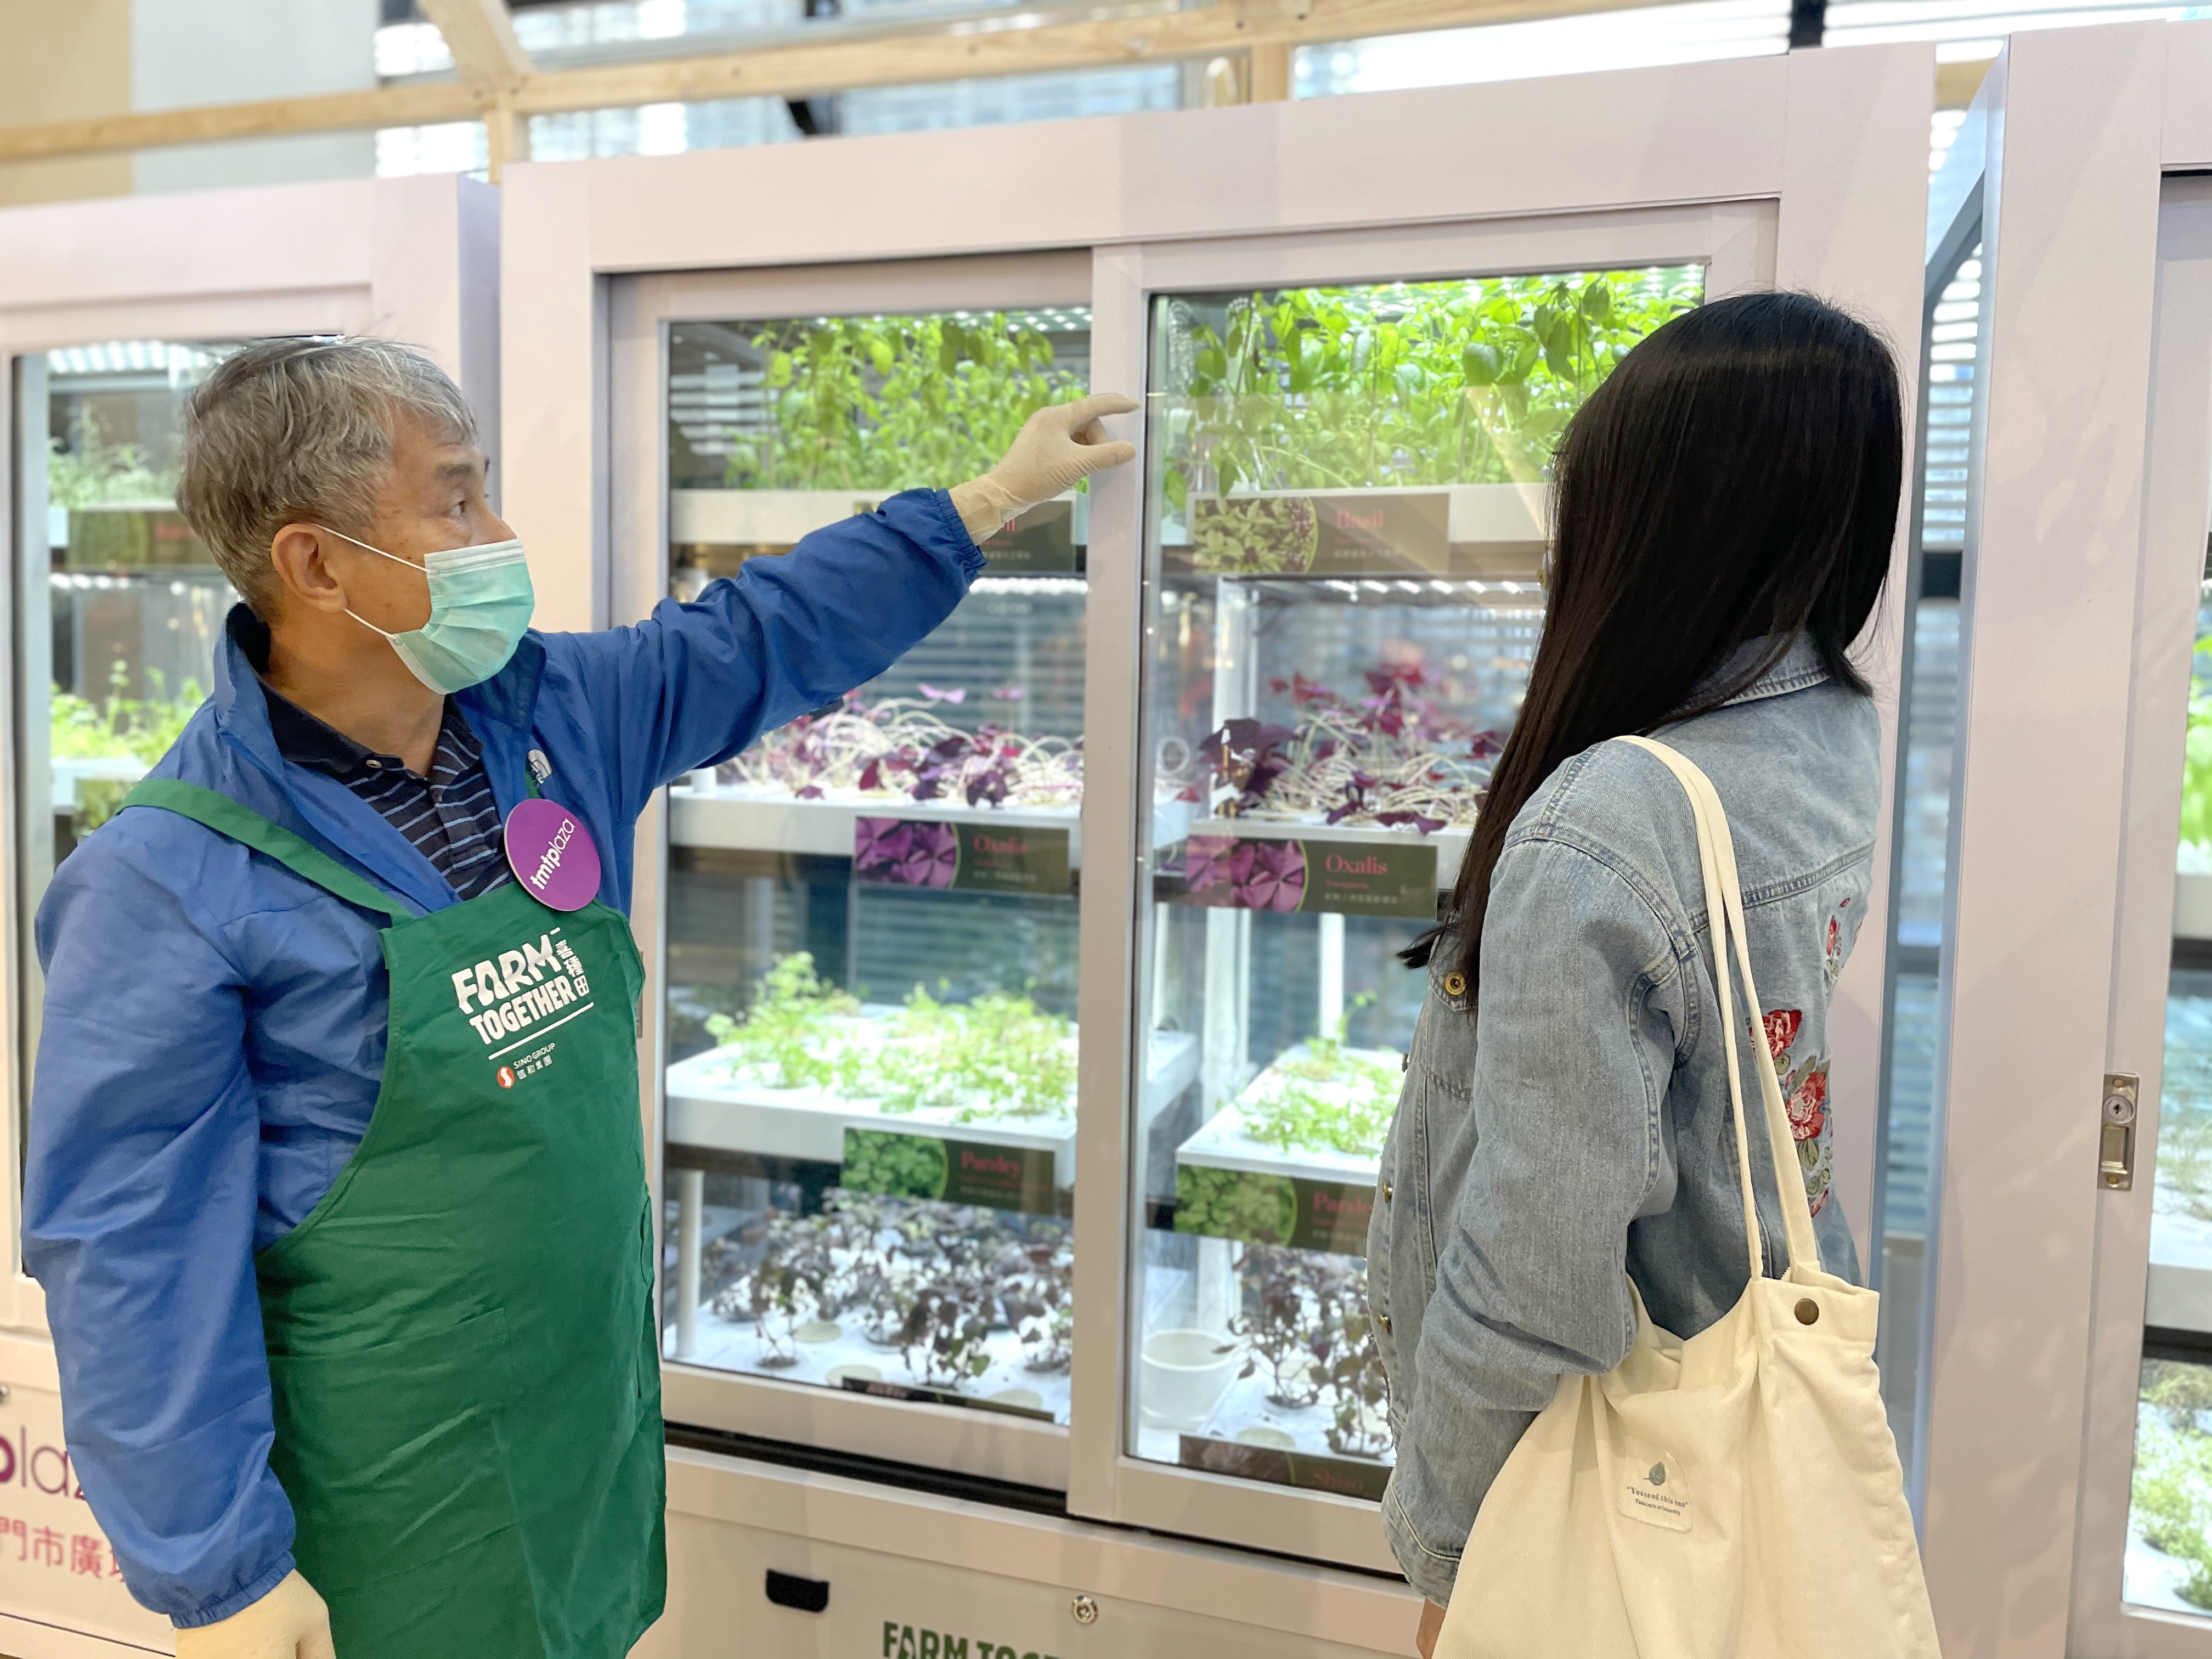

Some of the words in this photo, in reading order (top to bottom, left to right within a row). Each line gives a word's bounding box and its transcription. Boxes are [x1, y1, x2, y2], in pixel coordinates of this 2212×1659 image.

[530, 818, 575, 890] tmtplaza
[1325, 854, 1388, 876] Oxalis
[451, 934, 562, 1014] FARM
[469, 975, 578, 1045] TOGETHER
[513, 1054, 532, 1069] SINO
[532, 1042, 555, 1059] GROUP
[883, 1621, 969, 1659] FARM
